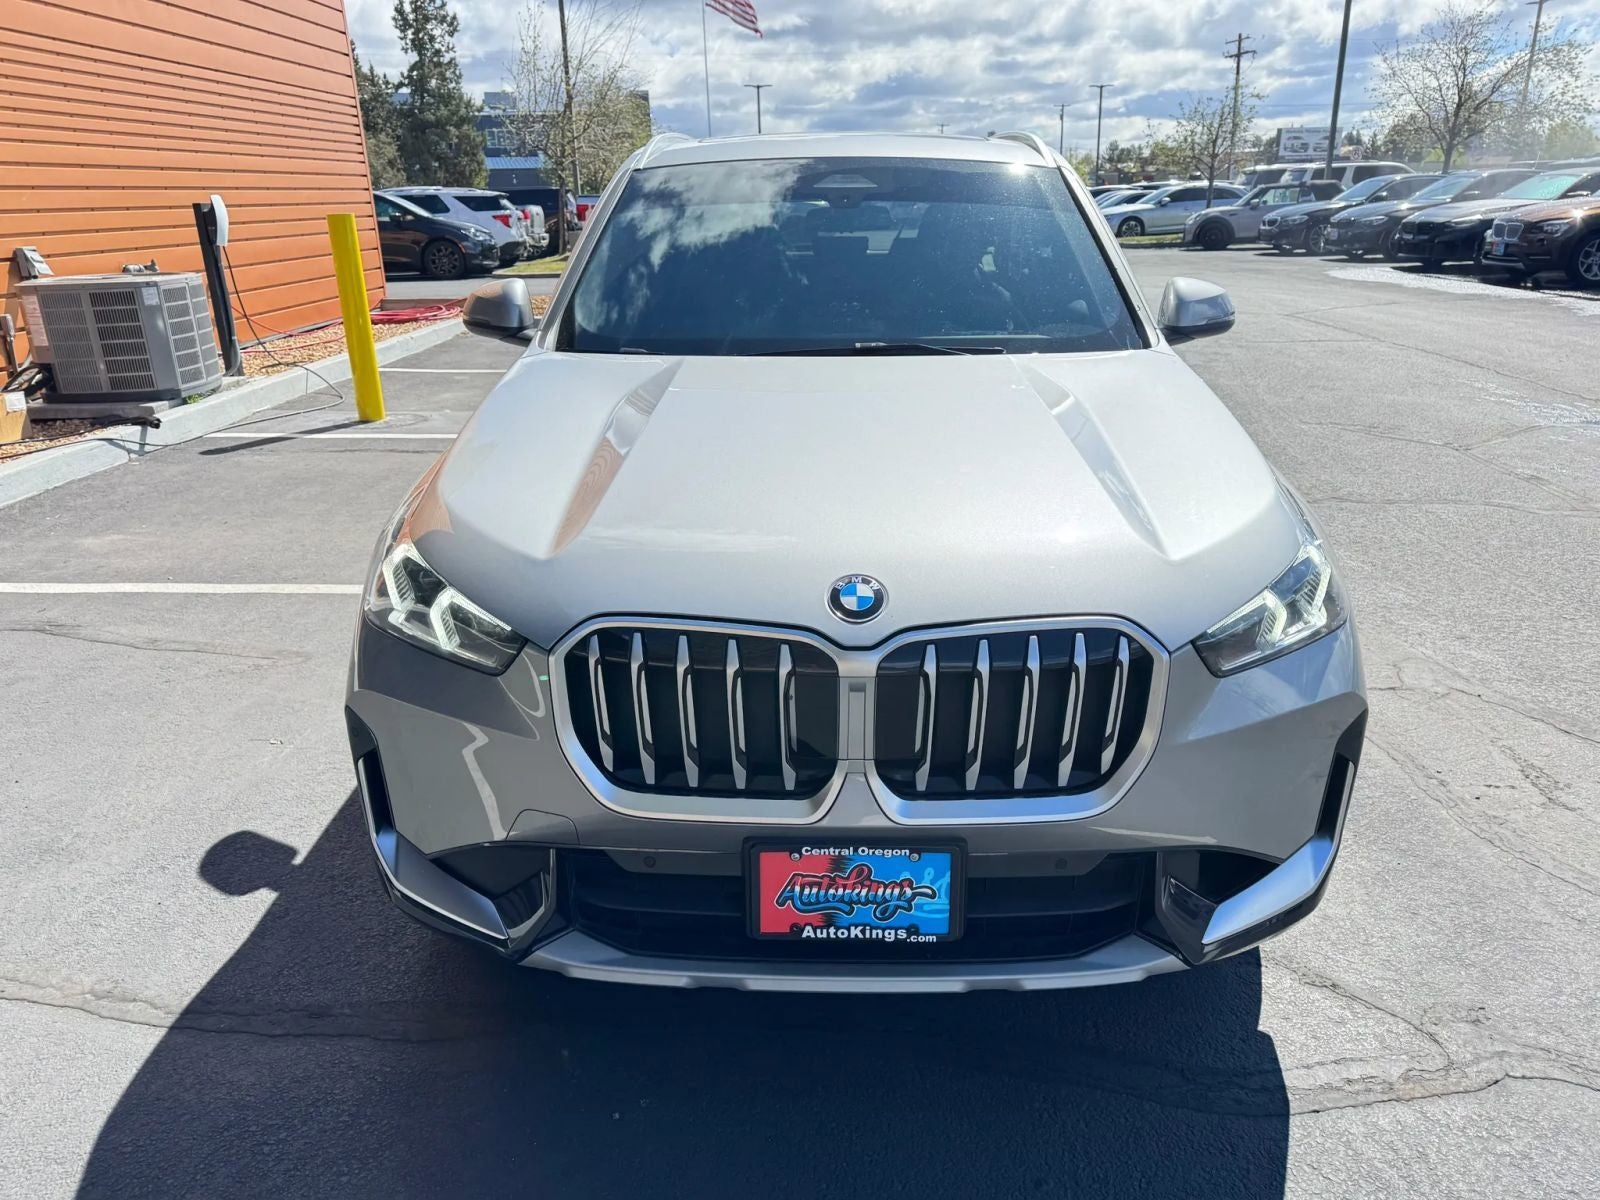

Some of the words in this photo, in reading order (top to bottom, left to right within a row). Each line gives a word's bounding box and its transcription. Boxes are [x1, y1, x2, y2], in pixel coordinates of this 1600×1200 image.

[834, 575, 881, 590] BMW
[801, 846, 854, 857] Central
[857, 846, 910, 857] Oregon
[801, 925, 937, 943] AutoKings.com
